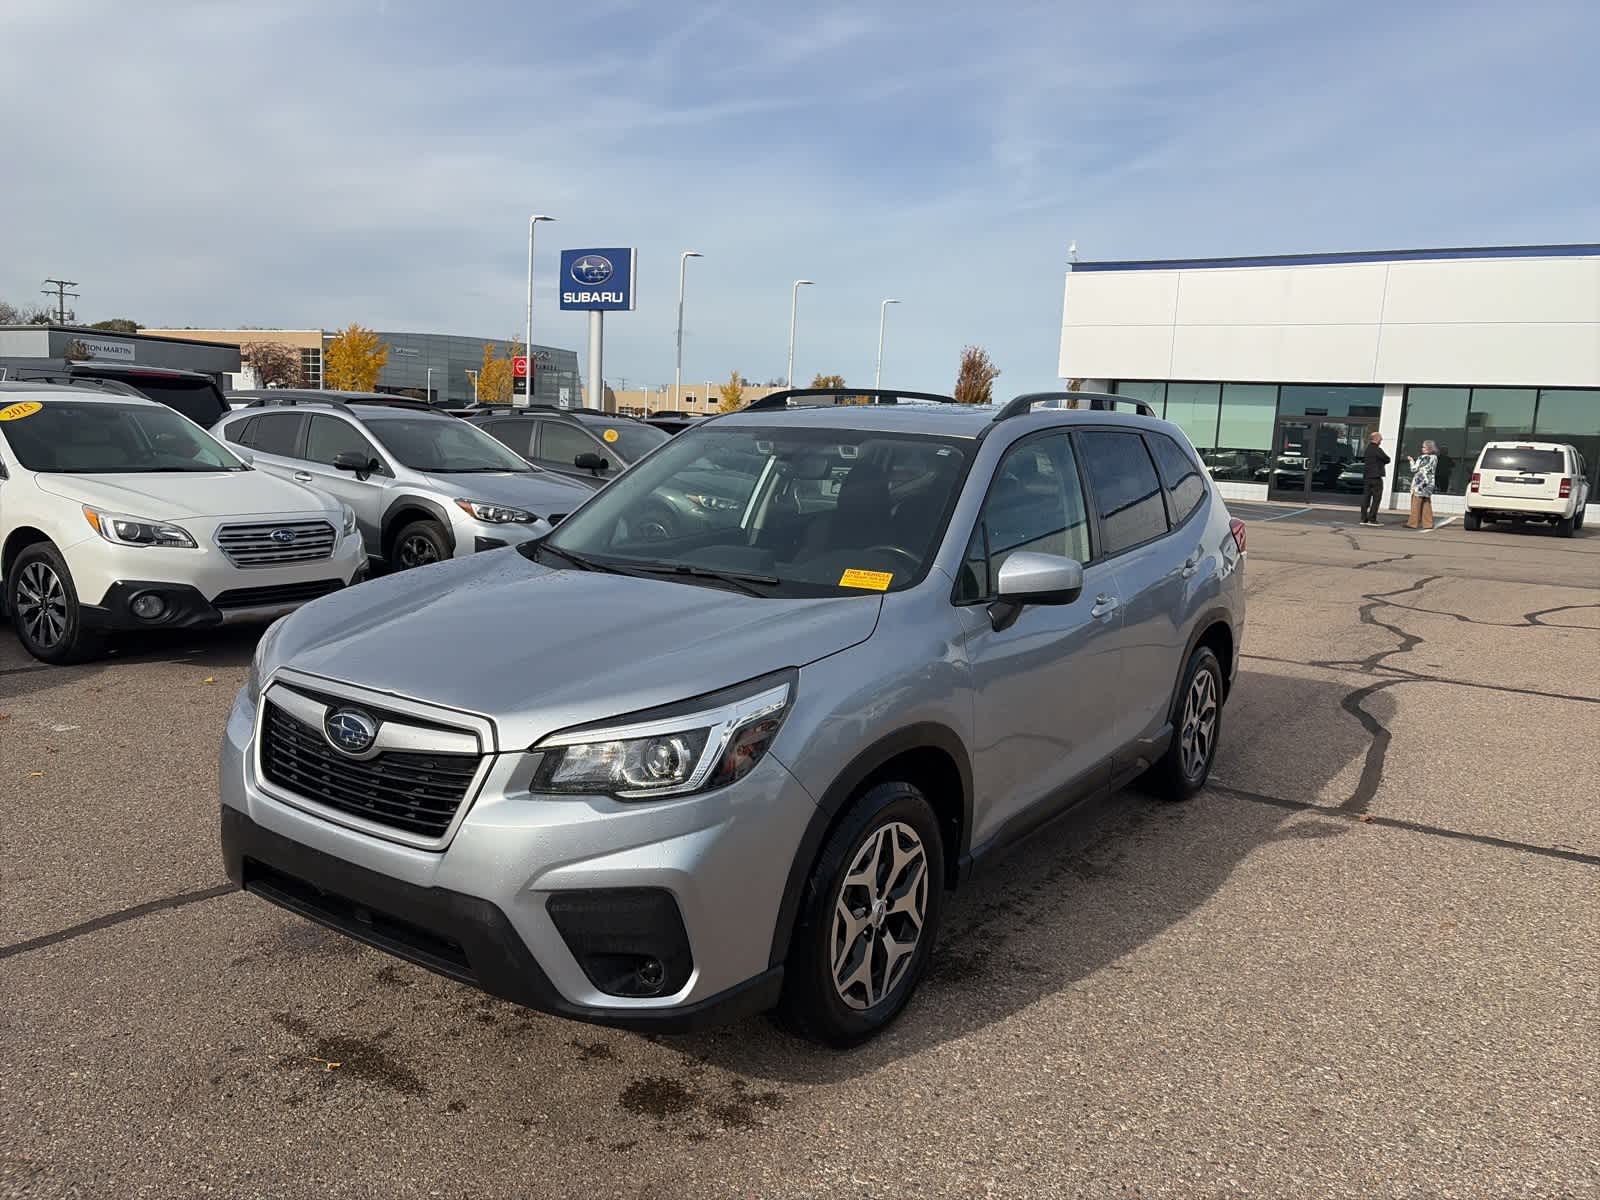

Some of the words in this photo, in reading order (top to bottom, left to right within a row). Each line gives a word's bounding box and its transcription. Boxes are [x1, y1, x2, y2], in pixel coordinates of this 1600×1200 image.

[563, 291, 624, 303] SUBARU
[103, 344, 131, 355] MARTIN
[4, 403, 34, 419] 2015
